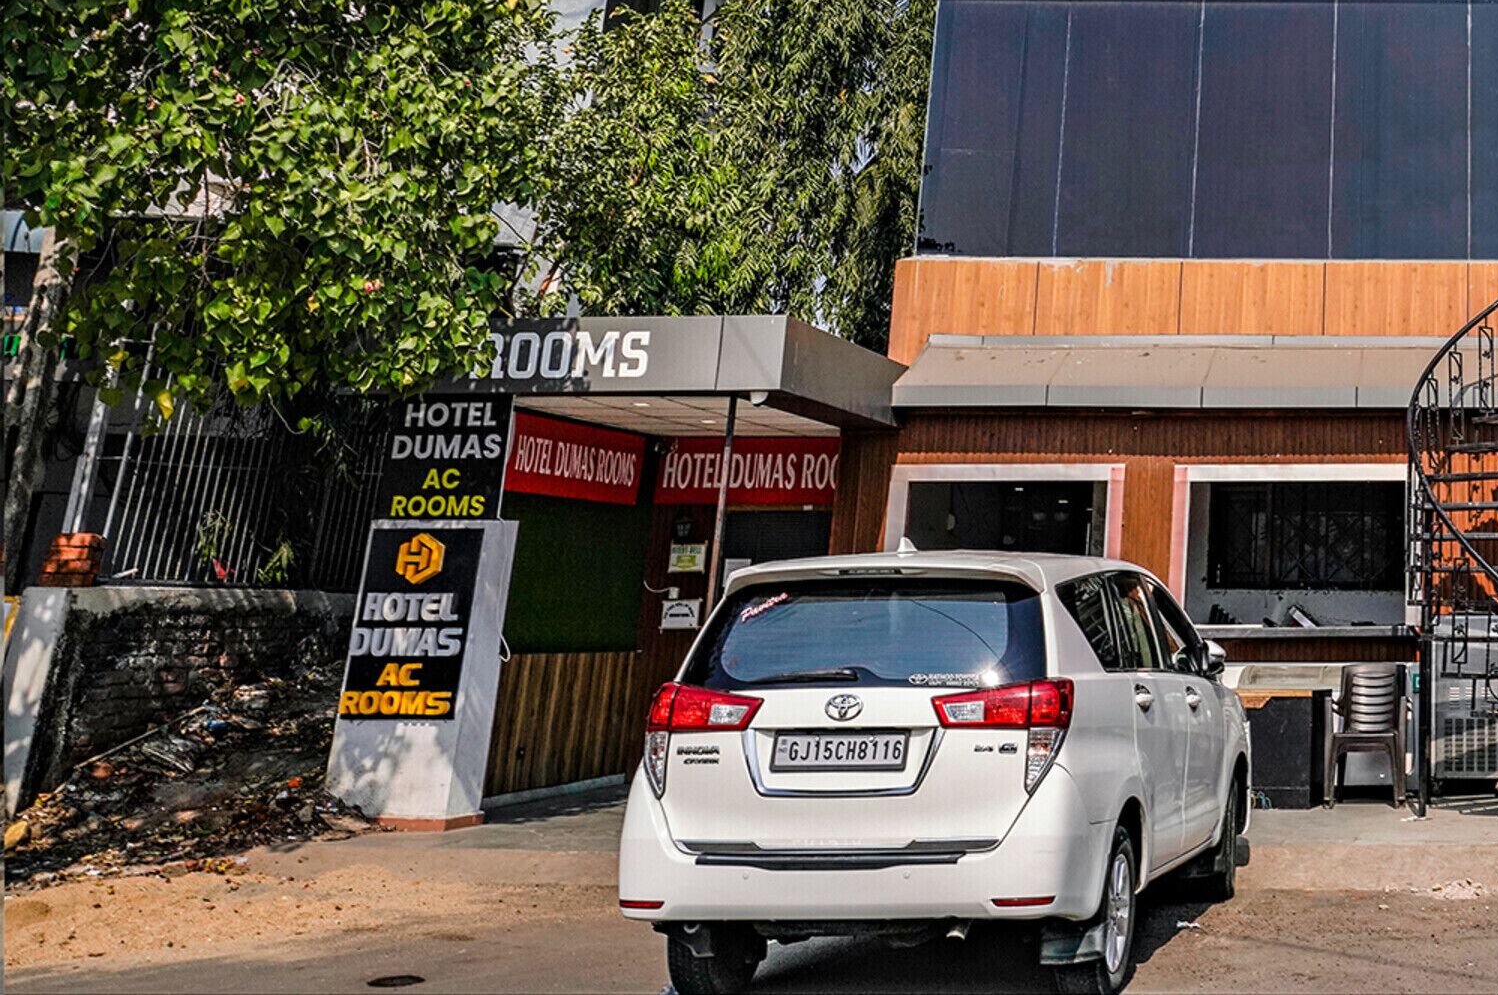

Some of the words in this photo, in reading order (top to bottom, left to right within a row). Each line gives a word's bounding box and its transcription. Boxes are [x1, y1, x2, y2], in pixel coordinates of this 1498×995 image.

[404, 402, 497, 427] HOTEL
[391, 433, 502, 460] DUMAS
[515, 435, 553, 475] HOTEL
[554, 441, 596, 482] DUMAS
[595, 448, 637, 487] ROOMS
[662, 453, 723, 489] HOTEL
[728, 453, 797, 490] DUMAS
[422, 468, 461, 489] AC
[390, 495, 486, 516] ROOMS
[362, 592, 459, 622] HOTEL
[350, 627, 463, 657] DUMAS
[376, 662, 423, 687] AC
[340, 691, 453, 716] ROOMS
[789, 740, 902, 761] GJ15CH8116
